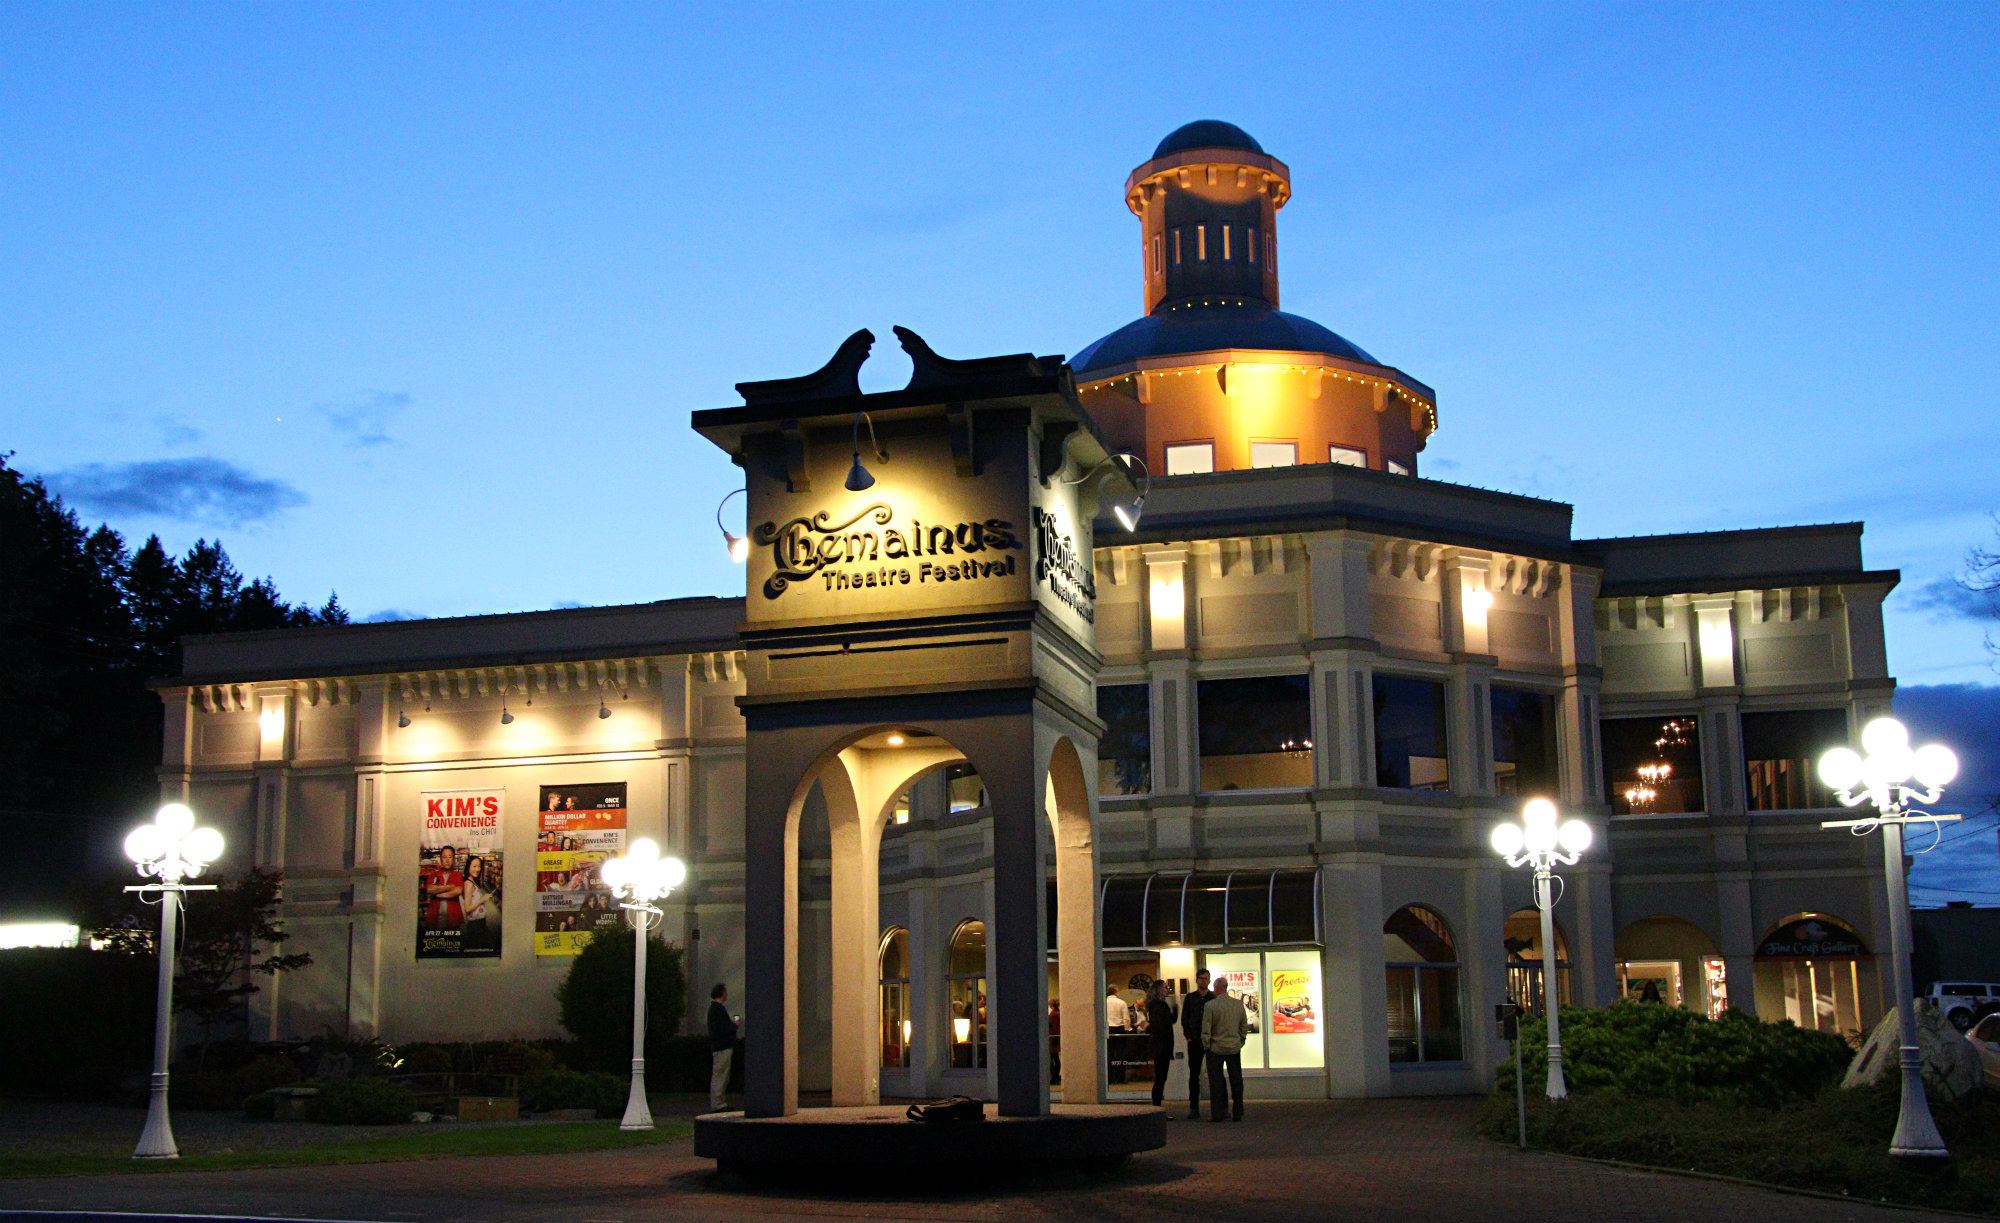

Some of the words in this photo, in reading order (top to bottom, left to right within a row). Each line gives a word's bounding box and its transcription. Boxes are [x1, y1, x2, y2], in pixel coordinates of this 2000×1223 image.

[760, 501, 1014, 594] Chemainus
[822, 567, 911, 590] Theatre
[918, 555, 1016, 583] Festival
[427, 796, 498, 818] KIM'S
[426, 816, 497, 829] CONVENIENCE
